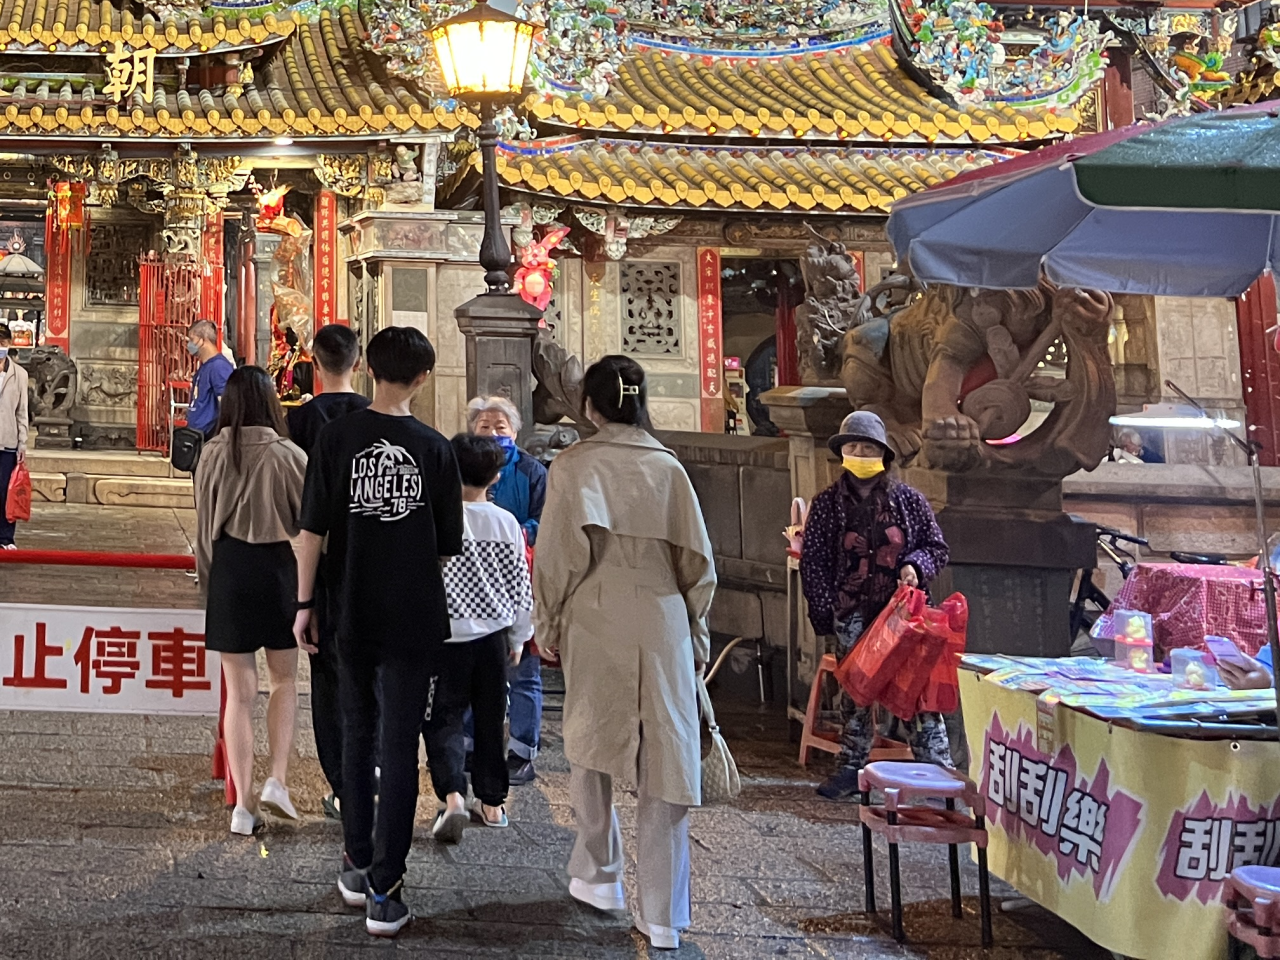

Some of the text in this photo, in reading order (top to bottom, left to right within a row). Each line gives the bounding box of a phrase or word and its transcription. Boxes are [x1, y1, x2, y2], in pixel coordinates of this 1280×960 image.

[352, 457, 376, 478] LOS
[353, 475, 419, 505] ANGELES
[391, 497, 407, 514] 78
[986, 741, 1110, 874] 刮刮樂
